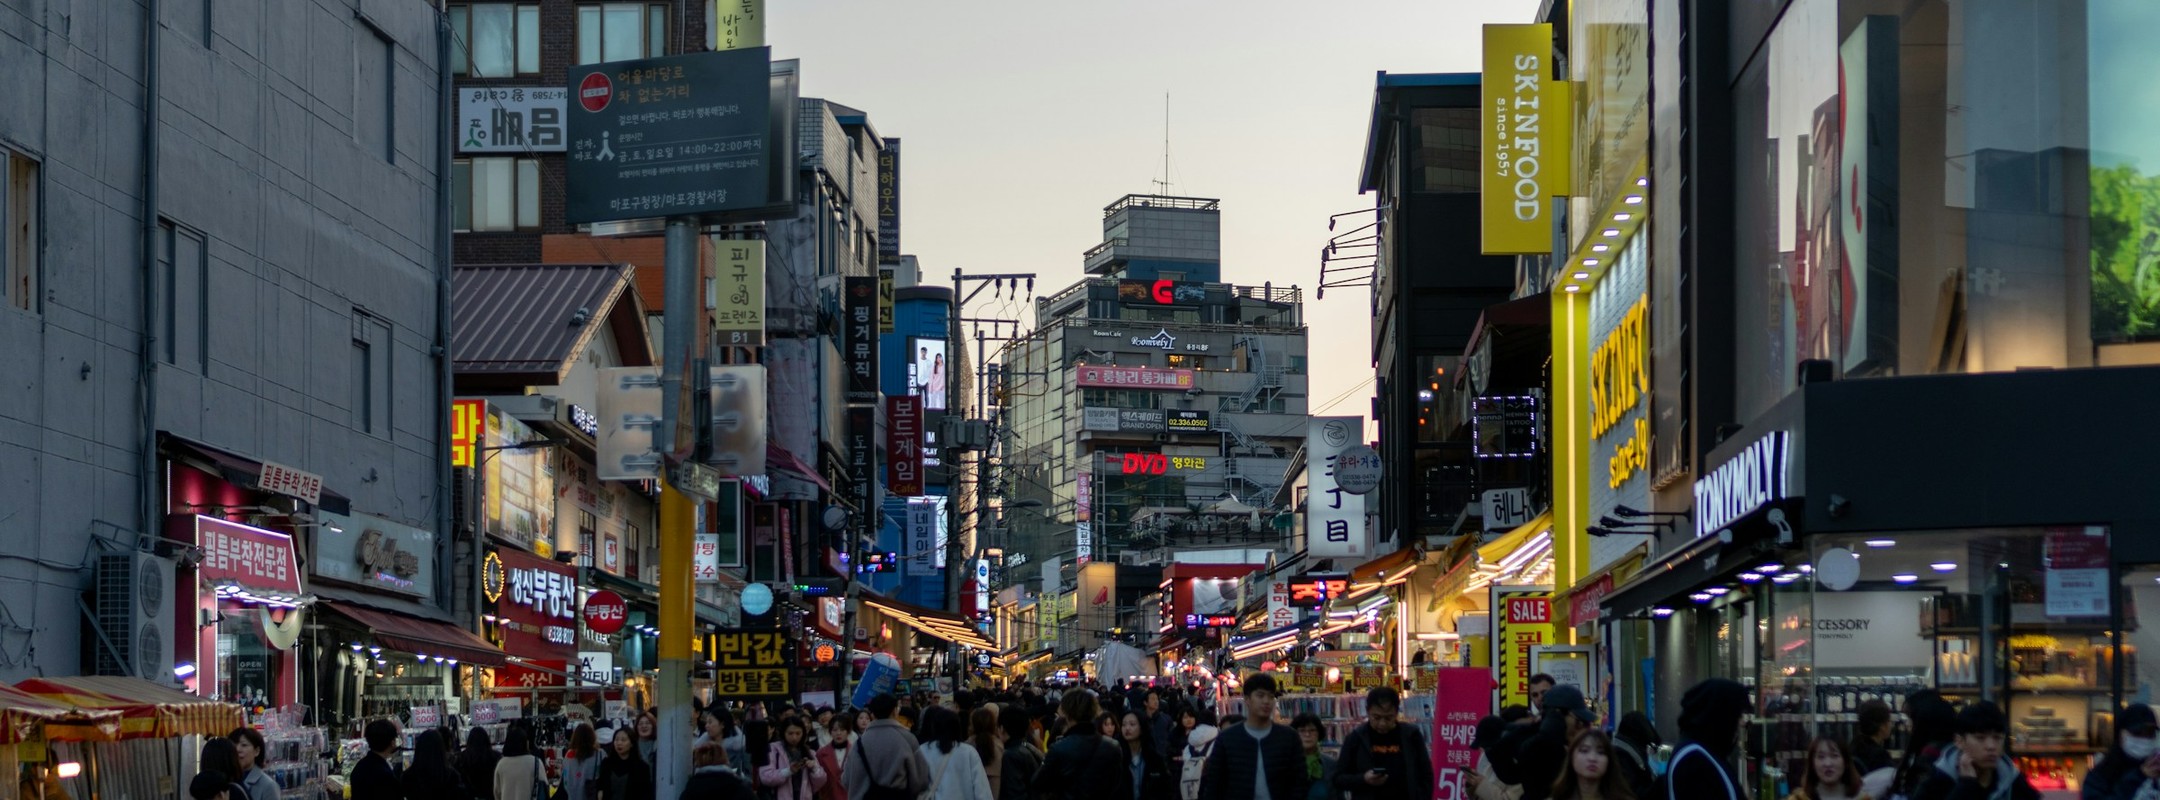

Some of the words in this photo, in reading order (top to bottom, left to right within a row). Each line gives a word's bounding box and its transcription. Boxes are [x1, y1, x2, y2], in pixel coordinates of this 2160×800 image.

[618, 90, 631, 104] 차
[1497, 97, 1508, 140] since
[1514, 54, 1540, 221] SKINFOOD
[1496, 144, 1510, 178] 1957
[879, 155, 896, 217] 더하우스
[719, 310, 760, 325] 프렌즈
[731, 332, 748, 344] B1
[853, 305, 871, 379] 핑거뮤직
[1121, 421, 1145, 430] GRAND
[1146, 422, 1164, 430] OPEN
[1168, 418, 1208, 427] 02.336.0502
[893, 399, 915, 481] 보드게임
[922, 457, 941, 466] ROUND
[1122, 452, 1168, 475] DVD
[1172, 456, 1206, 470] 영화관
[1609, 437, 1635, 489] since
[263, 465, 300, 495] 필름부착
[300, 475, 320, 499] 전문
[894, 483, 917, 494] Cafe
[1694, 430, 1777, 538] TONYMOLY
[1492, 488, 1527, 526] 헤나
[915, 512, 929, 565] 네일아트
[204, 530, 287, 581] 필름부착전문점
[511, 567, 576, 618] 성신부동산
[585, 604, 625, 620] 부동산
[1512, 600, 1546, 621] SALE
[719, 632, 786, 666] 반값
[719, 670, 788, 695] 방탈출
[1296, 675, 1321, 687] 15000
[1356, 676, 1381, 687] 10000
[415, 706, 437, 715] SALE
[415, 715, 437, 724] 5000
[475, 712, 497, 721] 5000
